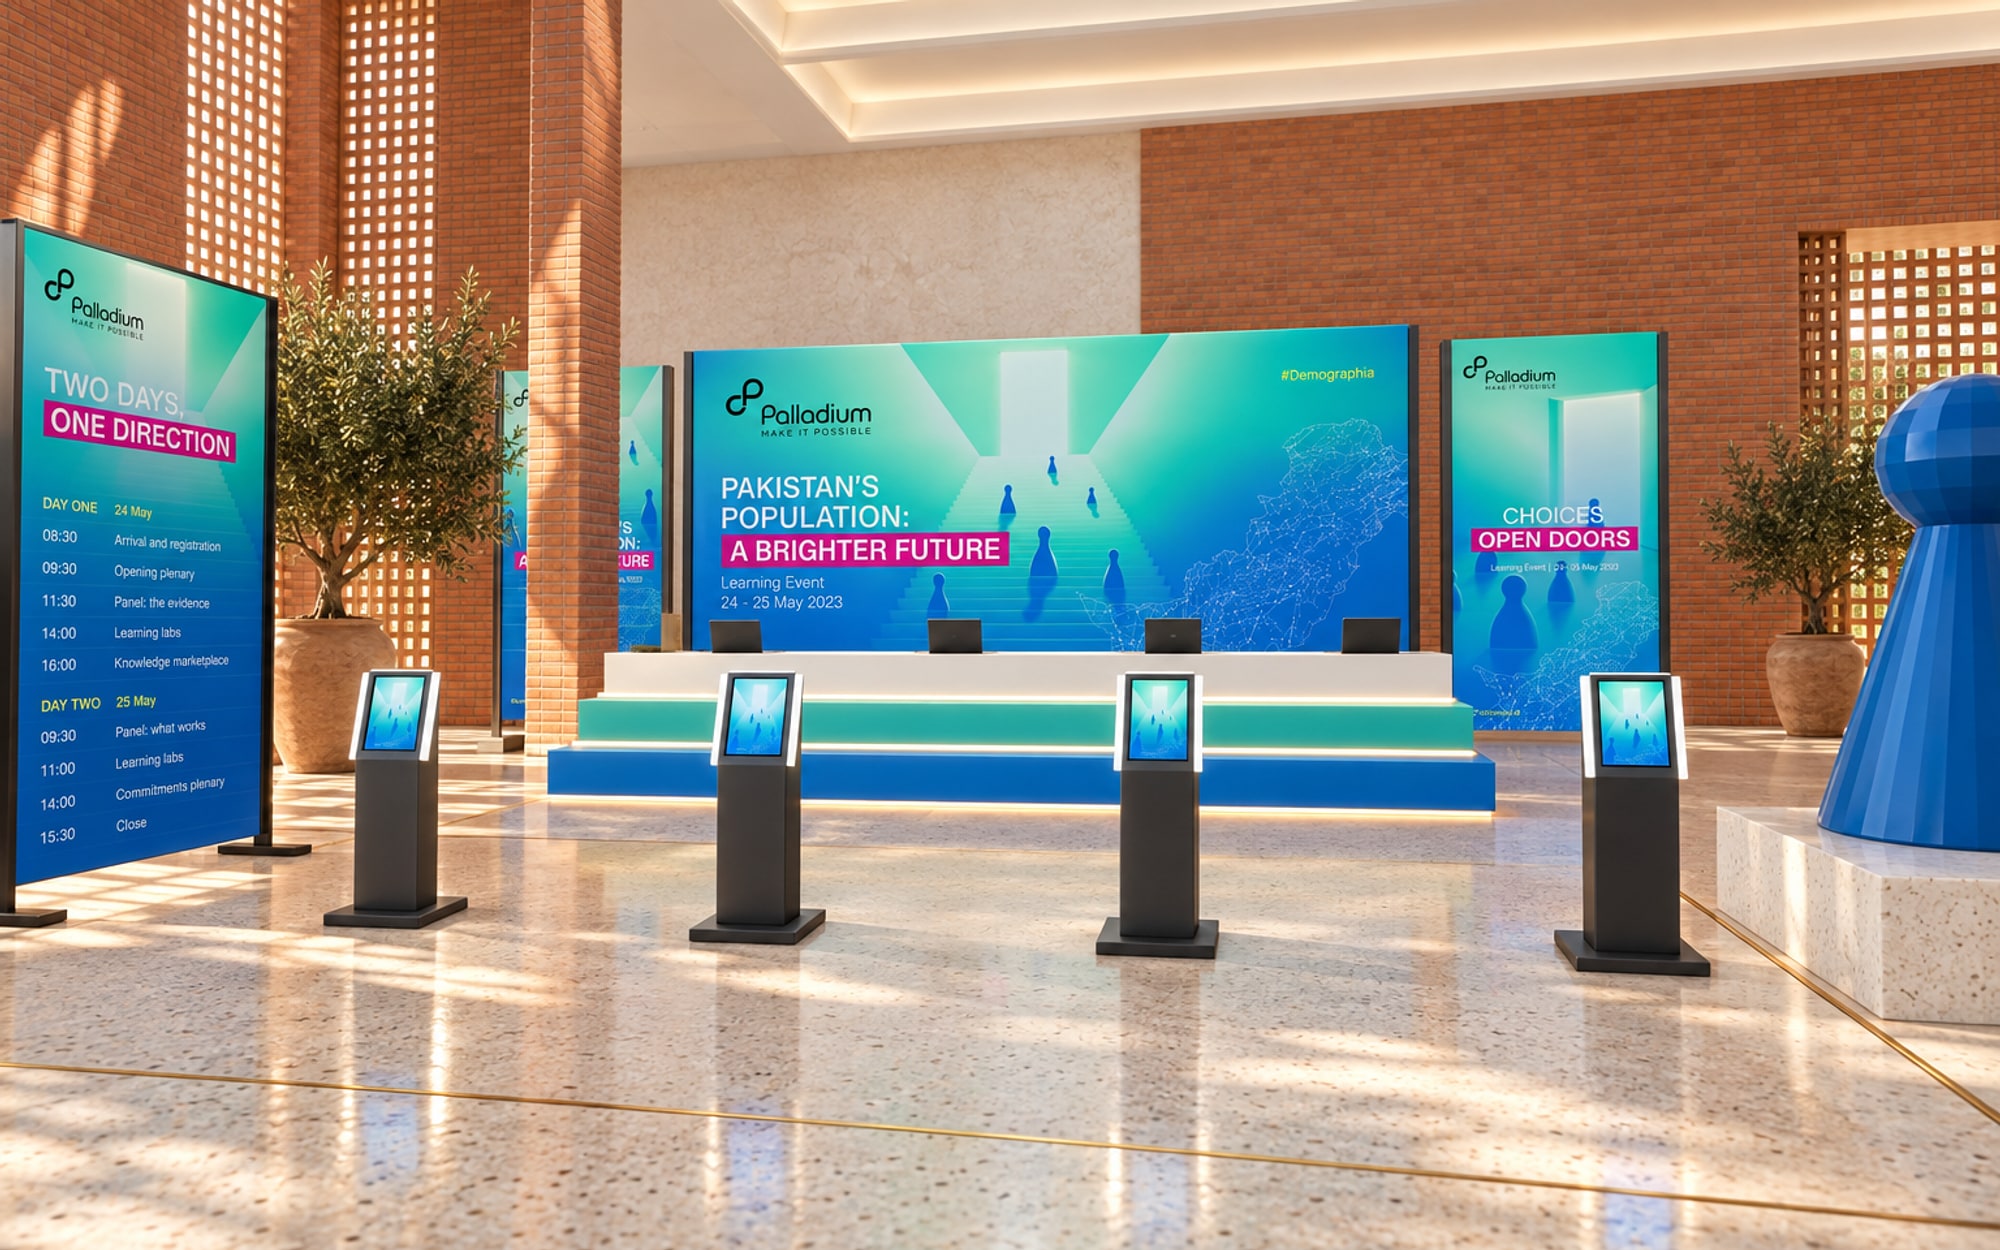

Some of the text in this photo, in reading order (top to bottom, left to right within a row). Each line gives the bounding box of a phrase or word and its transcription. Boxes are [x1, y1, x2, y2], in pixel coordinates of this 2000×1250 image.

[71, 296, 144, 330] Palladium
[1281, 367, 1375, 383] #Demographia
[1485, 369, 1557, 384] Palladium
[44, 366, 184, 420] TWO DAYS,
[761, 403, 872, 426] Palladium
[51, 407, 230, 458] ONE DIRECTION
[761, 426, 872, 437] MAKE IT POSSIBLE
[721, 474, 880, 500] PAKISTAN'S
[43, 496, 98, 514] DAY ONE
[114, 503, 153, 521] 24 May
[721, 504, 910, 530] POPULATION:
[1502, 506, 1605, 525] CHOICES
[42, 528, 78, 544] 08:30
[114, 534, 222, 553] Arrival and registration
[1478, 530, 1631, 549] OPEN DOORS
[729, 536, 1001, 563] A BRIGHTER FUTURE
[42, 561, 77, 576] 09:30
[114, 564, 196, 583] Opening plenary
[721, 574, 825, 593] Learning Event
[41, 594, 77, 608] 11:30
[114, 595, 211, 610] Panel: the evidence
[721, 596, 738, 610] 24
[752, 596, 770, 609] 25
[774, 595, 804, 613] May
[807, 594, 844, 609] 2023
[41, 626, 77, 640] 14:00
[114, 626, 182, 641] Learning labs
[41, 658, 77, 672] 16:00
[114, 656, 171, 671] Knowledge
[41, 697, 102, 713] DAY TWO
[116, 694, 157, 709] 25 May
[40, 729, 77, 744] 09:30
[115, 719, 207, 739] Panel: what works
[40, 761, 76, 777] 11:00
[115, 751, 185, 770] Learning labs
[115, 777, 226, 801] Commitments plenary
[40, 794, 76, 811] 14:00
[115, 818, 148, 833] Close
[40, 827, 76, 844] 15:30
